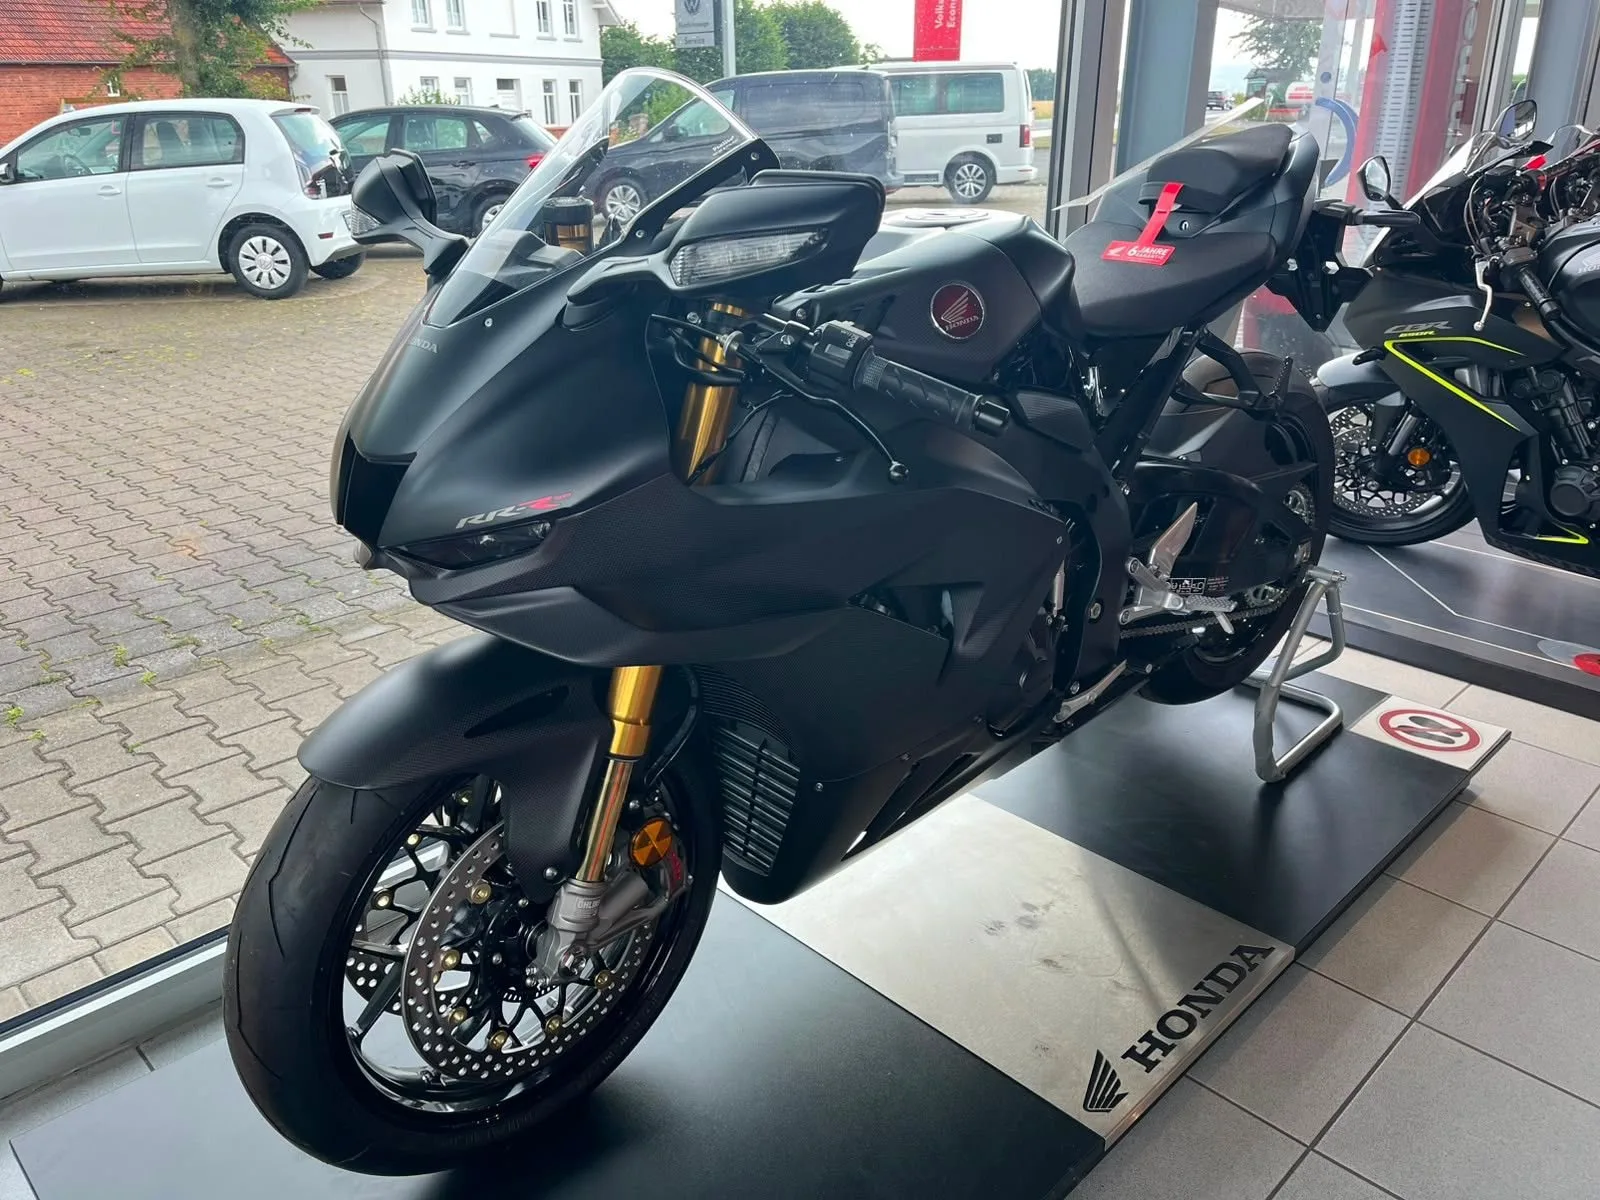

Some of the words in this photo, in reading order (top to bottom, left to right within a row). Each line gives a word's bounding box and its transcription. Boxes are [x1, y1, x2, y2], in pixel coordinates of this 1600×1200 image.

[1127, 246, 1139, 257] 6
[1139, 246, 1169, 256] JAHRE
[945, 315, 979, 331] HONDA
[1383, 320, 1453, 335] CBR
[1121, 944, 1275, 1074] HONDA
